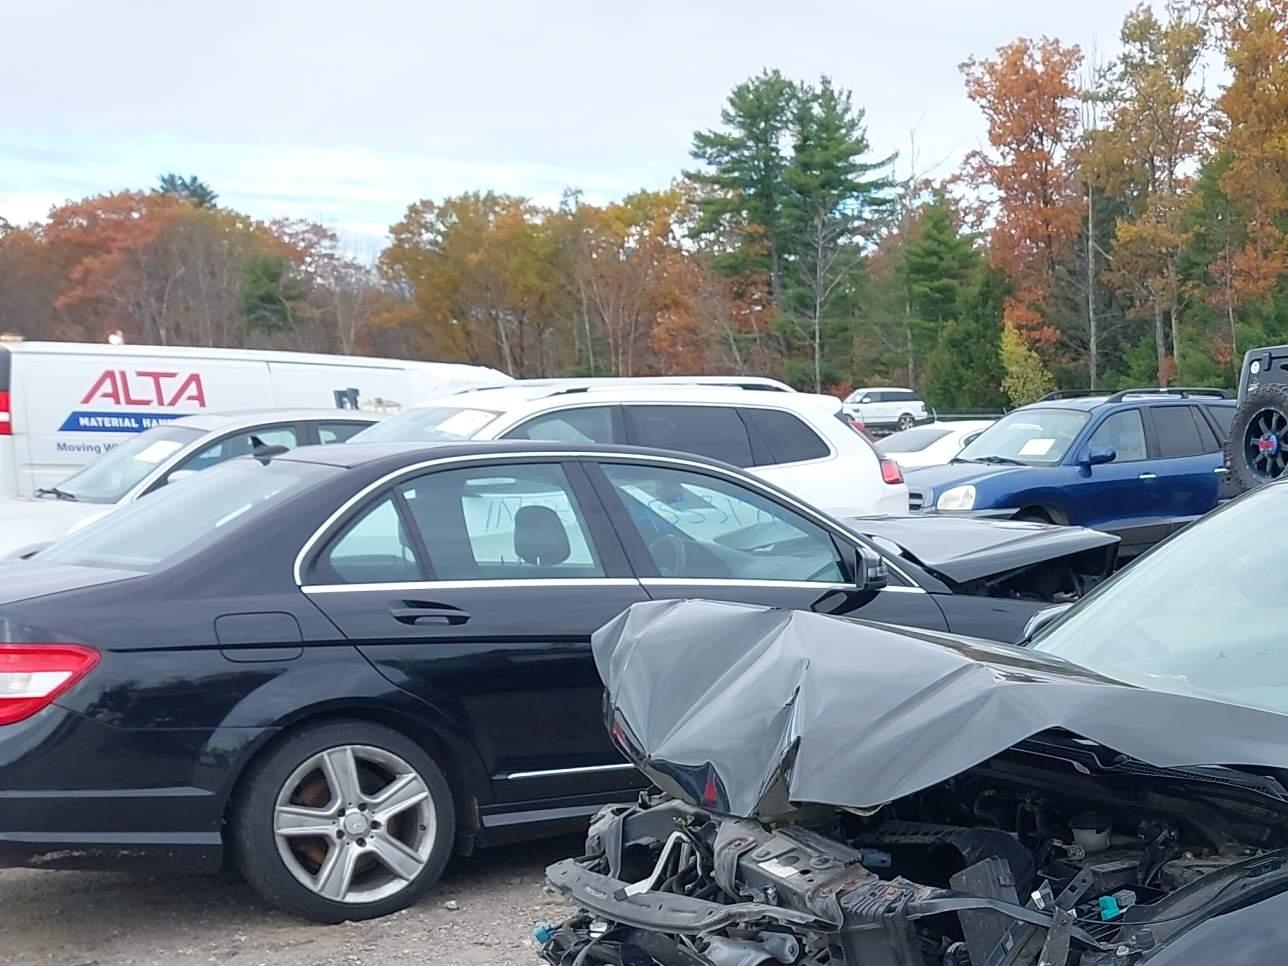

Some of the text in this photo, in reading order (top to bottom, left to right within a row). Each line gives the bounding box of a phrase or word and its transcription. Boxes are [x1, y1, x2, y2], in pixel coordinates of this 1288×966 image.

[80, 370, 206, 408] ALTA
[78, 416, 139, 428] MATERIAL
[56, 442, 102, 454] Moving
